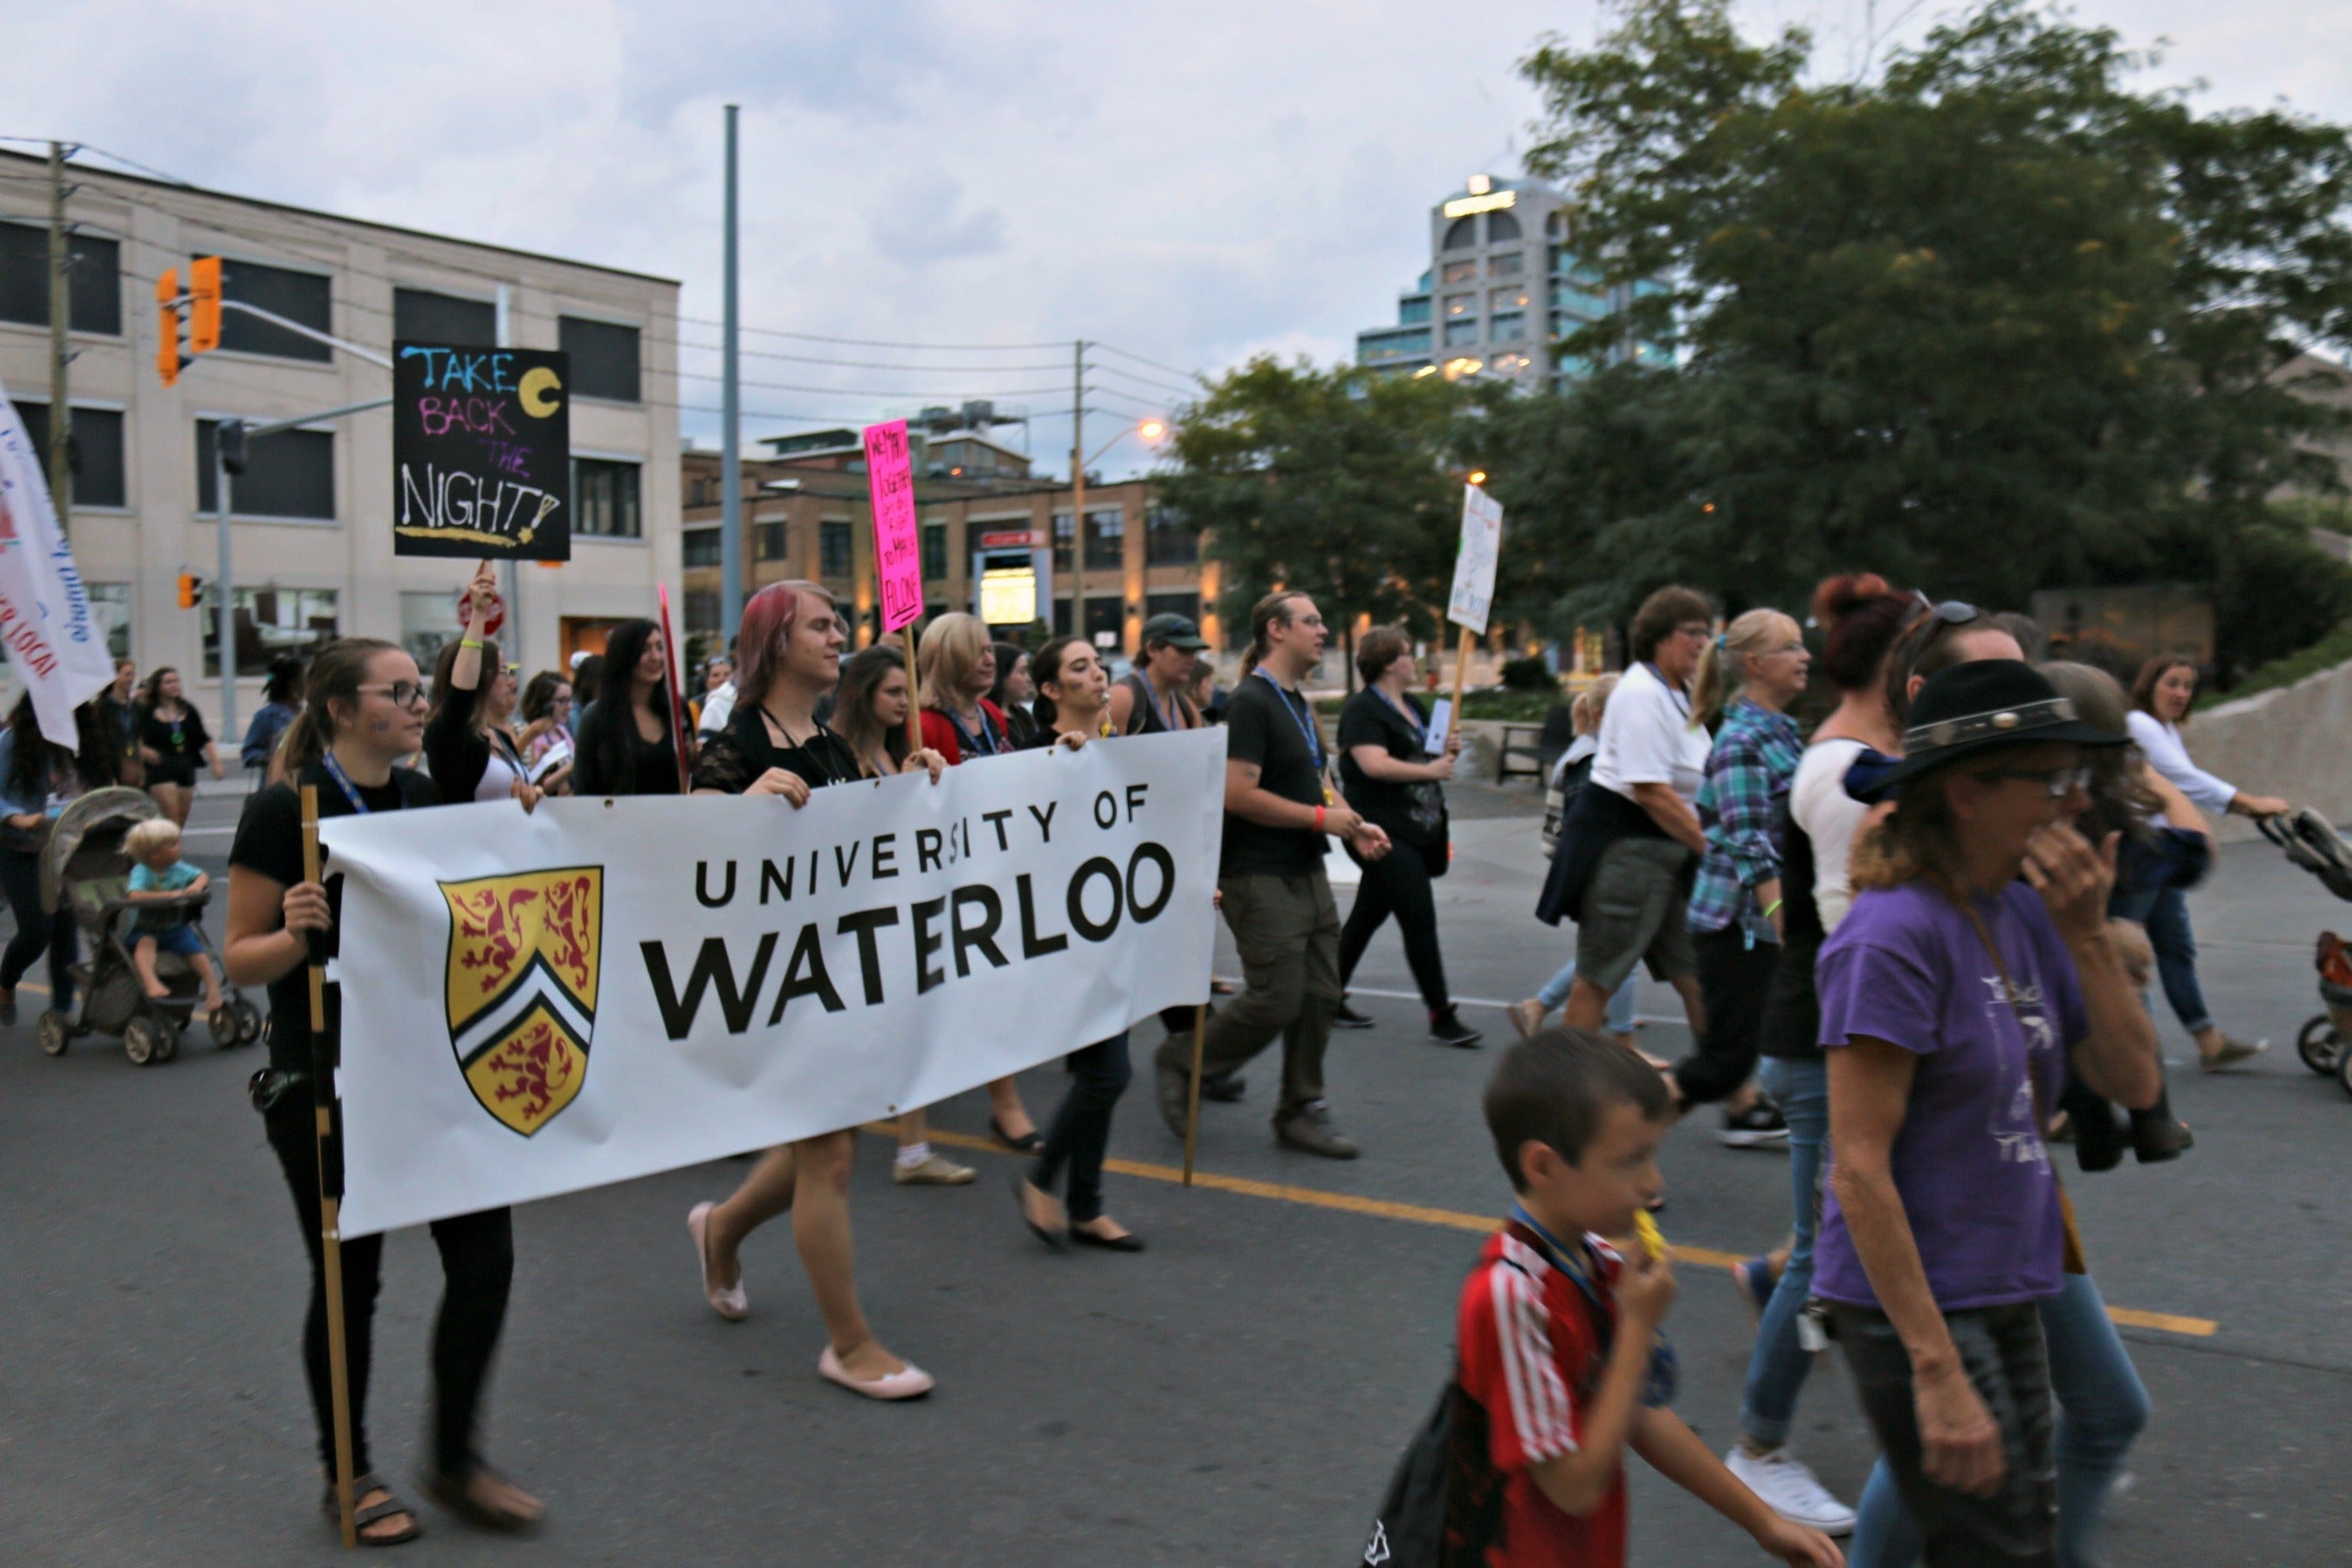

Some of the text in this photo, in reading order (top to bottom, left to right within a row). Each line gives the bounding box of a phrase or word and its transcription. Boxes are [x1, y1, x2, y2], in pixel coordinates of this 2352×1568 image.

[401, 346, 518, 393] TAKE
[419, 395, 516, 436] BACK
[476, 437, 535, 479] THE
[5, 621, 58, 681] LOCAL
[695, 783, 1149, 909] UNIVERSITY OF
[639, 842, 1176, 1043] WATERLOO
